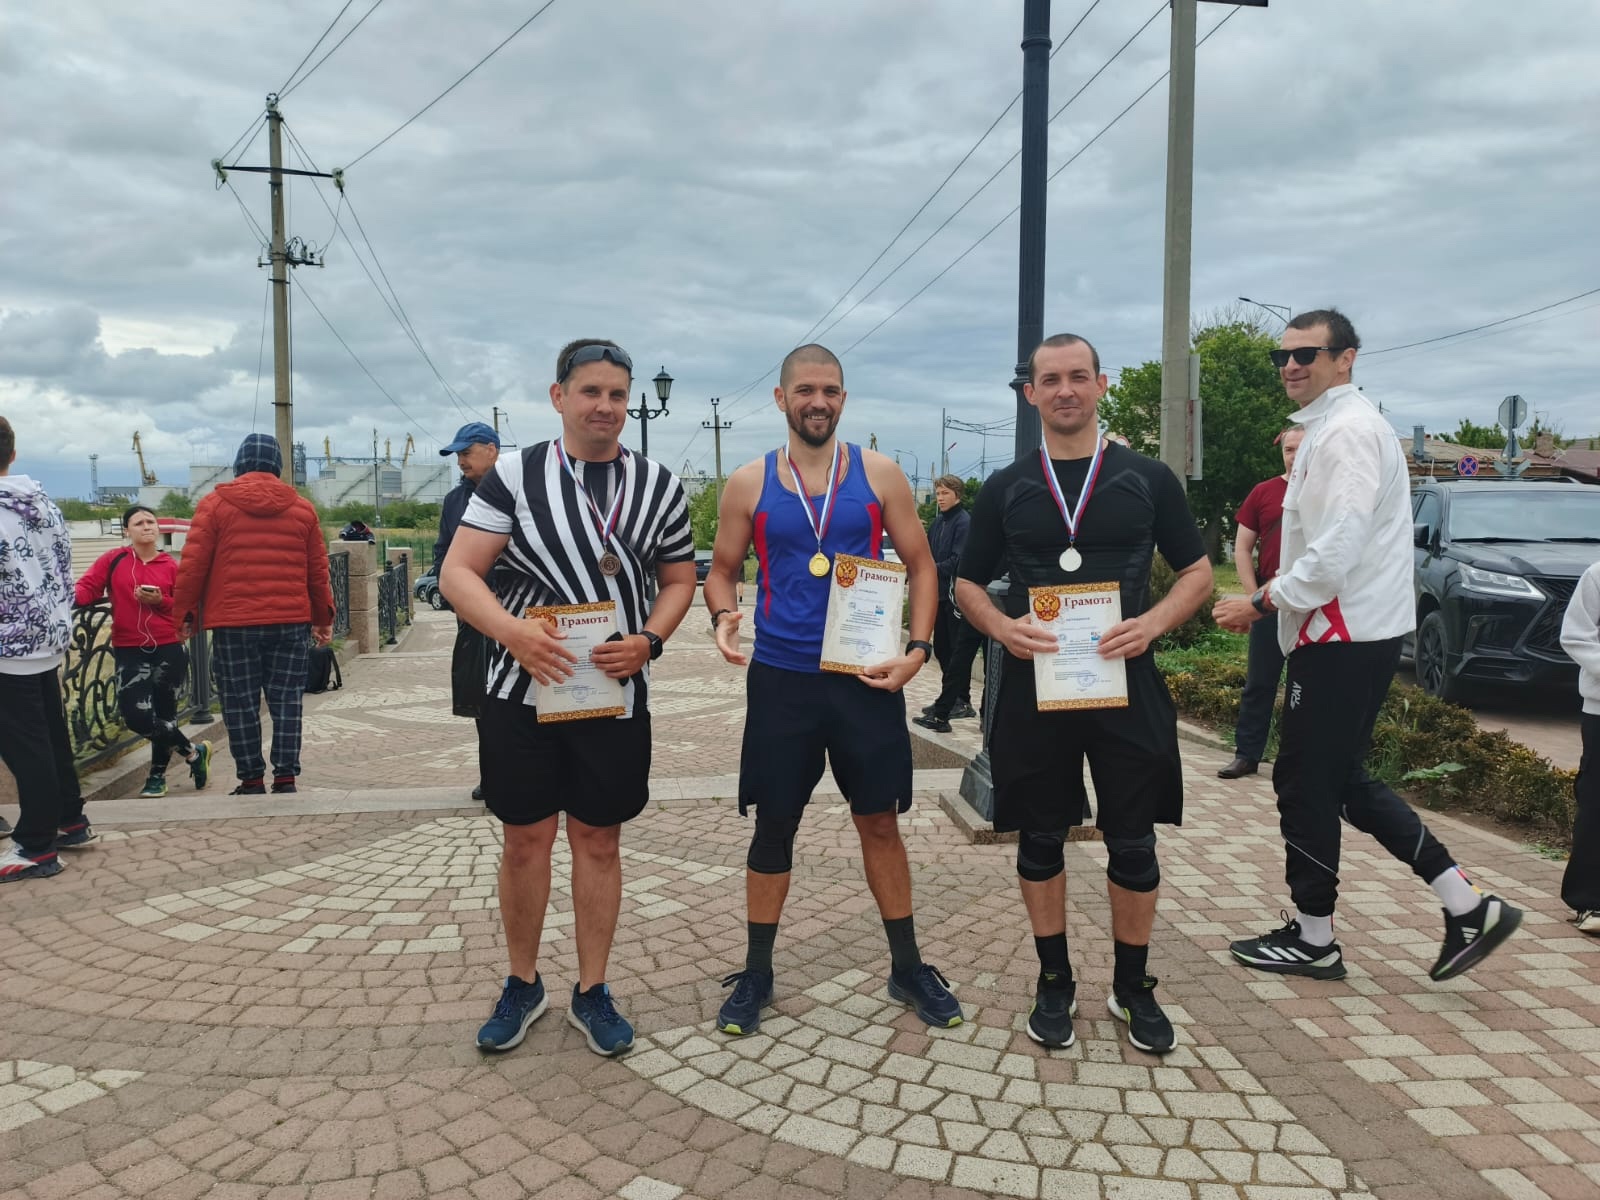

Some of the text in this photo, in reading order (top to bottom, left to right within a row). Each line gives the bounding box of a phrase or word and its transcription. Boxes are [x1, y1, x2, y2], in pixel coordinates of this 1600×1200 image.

[860, 569, 898, 583] Грамота
[1064, 597, 1112, 609] Грамота
[560, 615, 609, 628] Грамота
